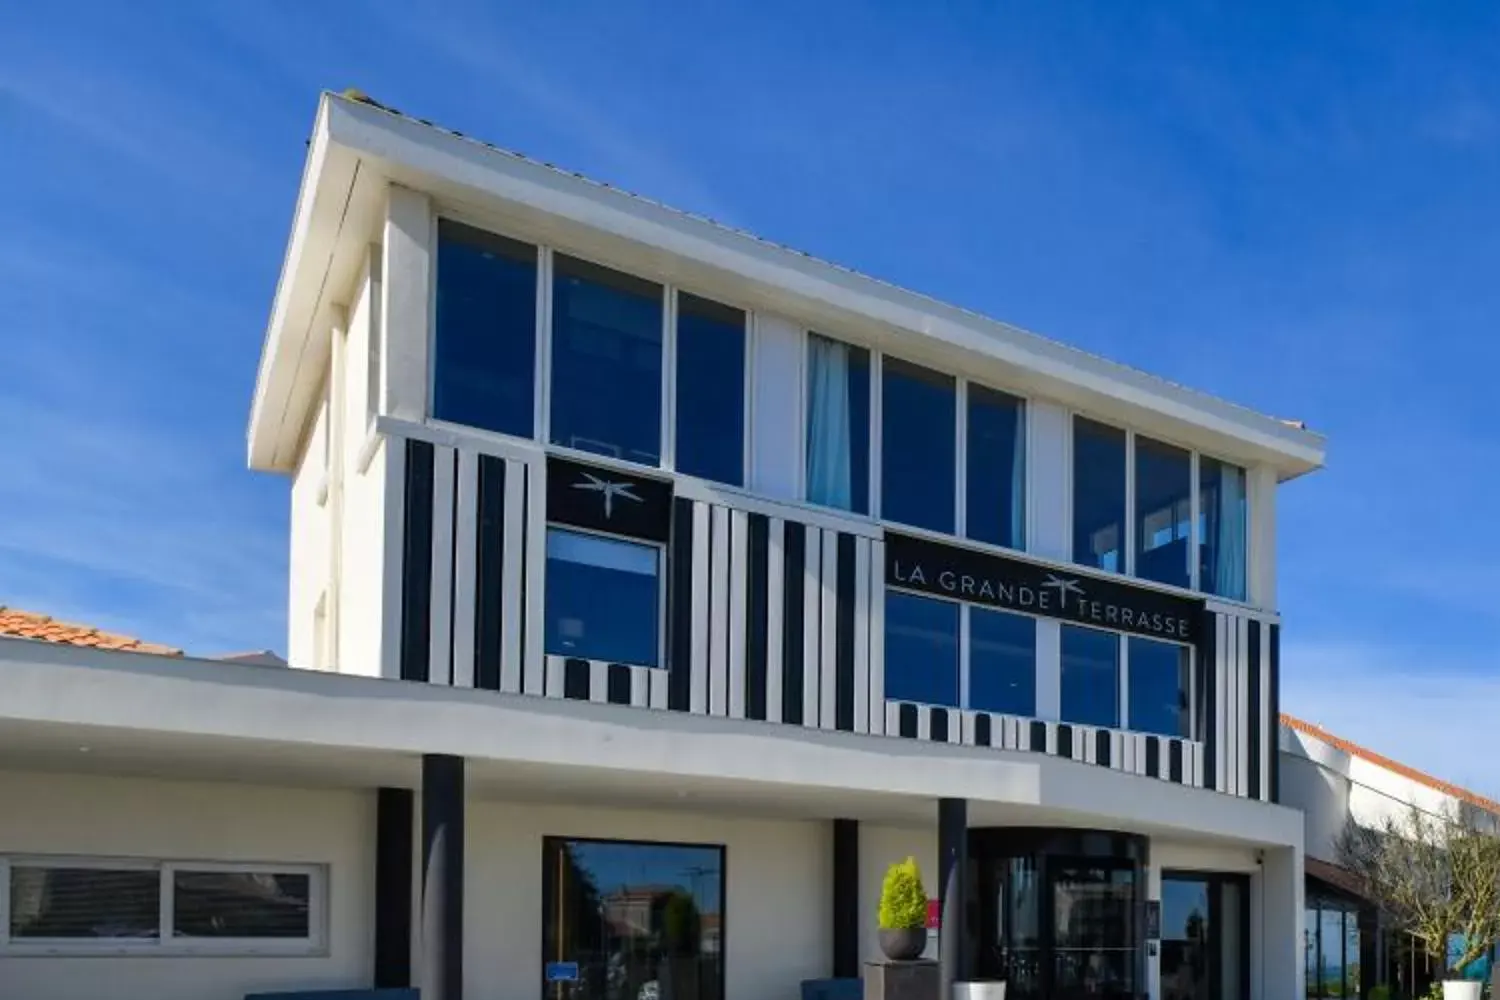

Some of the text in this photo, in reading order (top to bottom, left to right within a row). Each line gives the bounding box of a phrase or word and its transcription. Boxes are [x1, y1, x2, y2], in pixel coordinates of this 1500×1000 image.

[894, 560, 1189, 637] LA GRANDE TERRASSE
